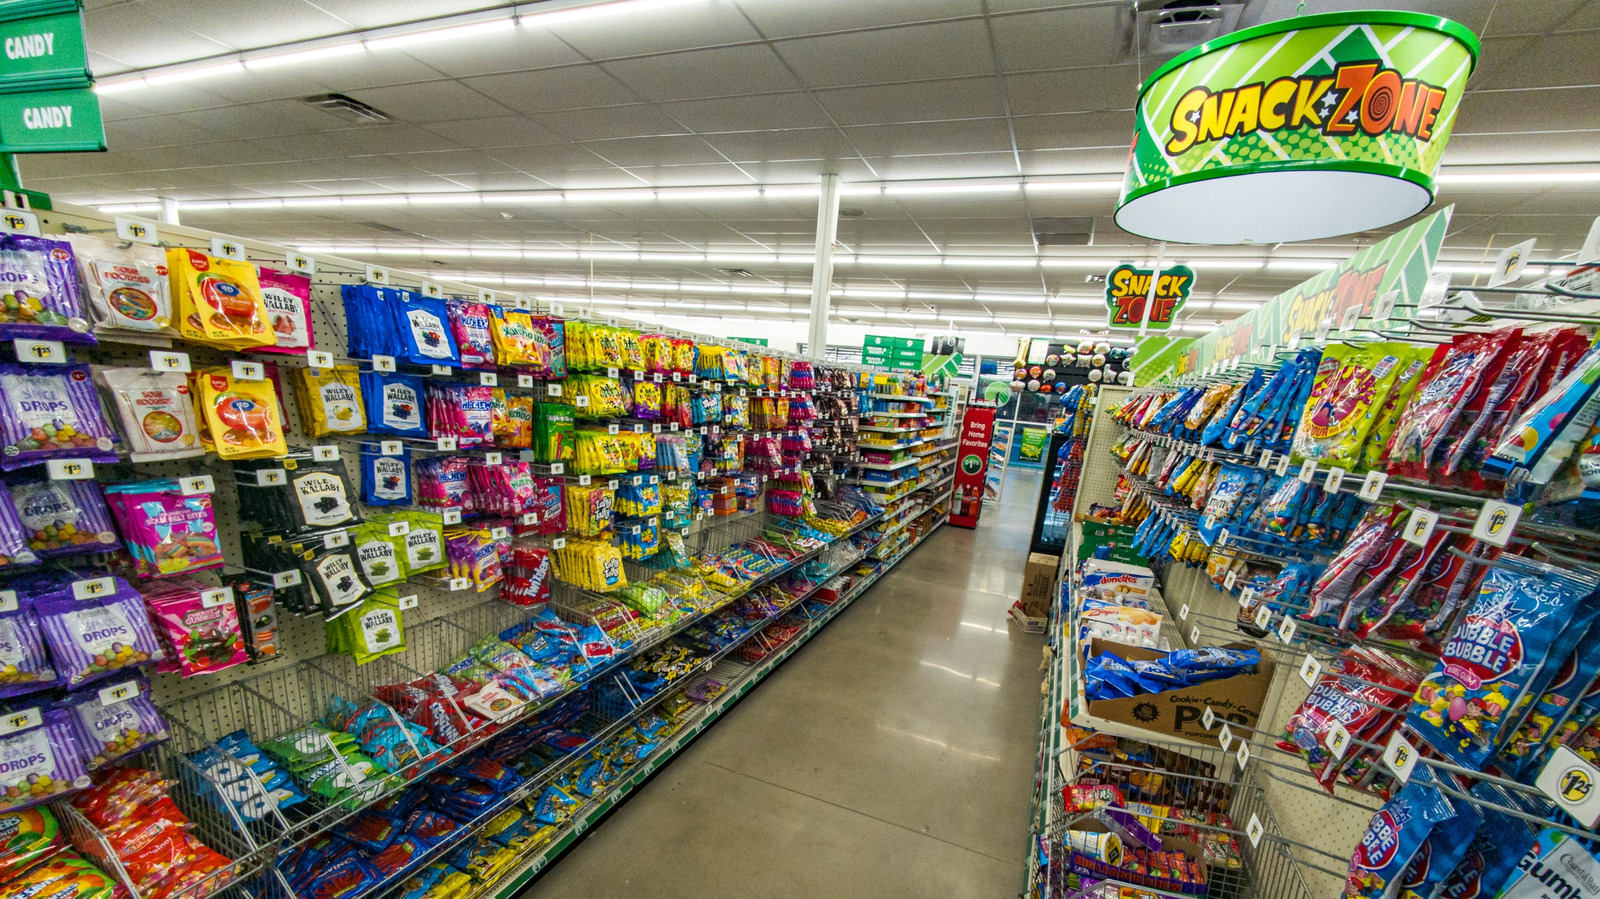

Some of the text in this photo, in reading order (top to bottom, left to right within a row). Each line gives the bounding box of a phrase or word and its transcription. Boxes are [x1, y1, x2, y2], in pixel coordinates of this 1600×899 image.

[5, 33, 54, 59] CANDY
[1167, 59, 1448, 156] SNACK ZONE
[24, 106, 72, 129] CANDY
[1111, 269, 1189, 297] SNACK
[265, 293, 294, 303] WILEY
[1282, 260, 1389, 345] SNACK ZONE
[1113, 296, 1177, 324] ZONE
[412, 319, 440, 329] WALLABY
[323, 393, 354, 402] WALLABY
[387, 392, 415, 401] WALLABY
[21, 400, 68, 412] DROPS
[970, 422, 986, 430] Bring
[962, 439, 987, 448] Favorites
[303, 478, 333, 487] WILEY
[301, 485, 340, 496] WALLABY
[24, 502, 70, 517] DROPS
[595, 495, 612, 511] Laffy
[146, 512, 208, 525] SOUR BELT BITES
[595, 506, 612, 522] Taffy
[408, 536, 437, 548] WALLABY
[409, 532, 432, 540] WILEY
[359, 550, 393, 562] WALLABY
[362, 545, 388, 554] WILEY
[324, 558, 343, 571] WILEY
[603, 557, 619, 569] Laffy
[603, 565, 619, 580] Taffy
[1101, 575, 1137, 584] donettes
[185, 611, 221, 626] GUMMIES
[187, 608, 216, 619] CHERRY
[366, 612, 388, 622] WILEY
[1088, 608, 1119, 617] Zingers
[364, 616, 393, 630] WALLABY
[82, 626, 127, 643] DROPS
[1444, 639, 1508, 674] BUBBLE
[1457, 669, 1476, 686] GUM
[1170, 695, 1233, 709] Cookie Candy
[95, 710, 133, 731] DROPS
[1174, 705, 1249, 732] POP
[0, 754, 46, 774] DROPS
